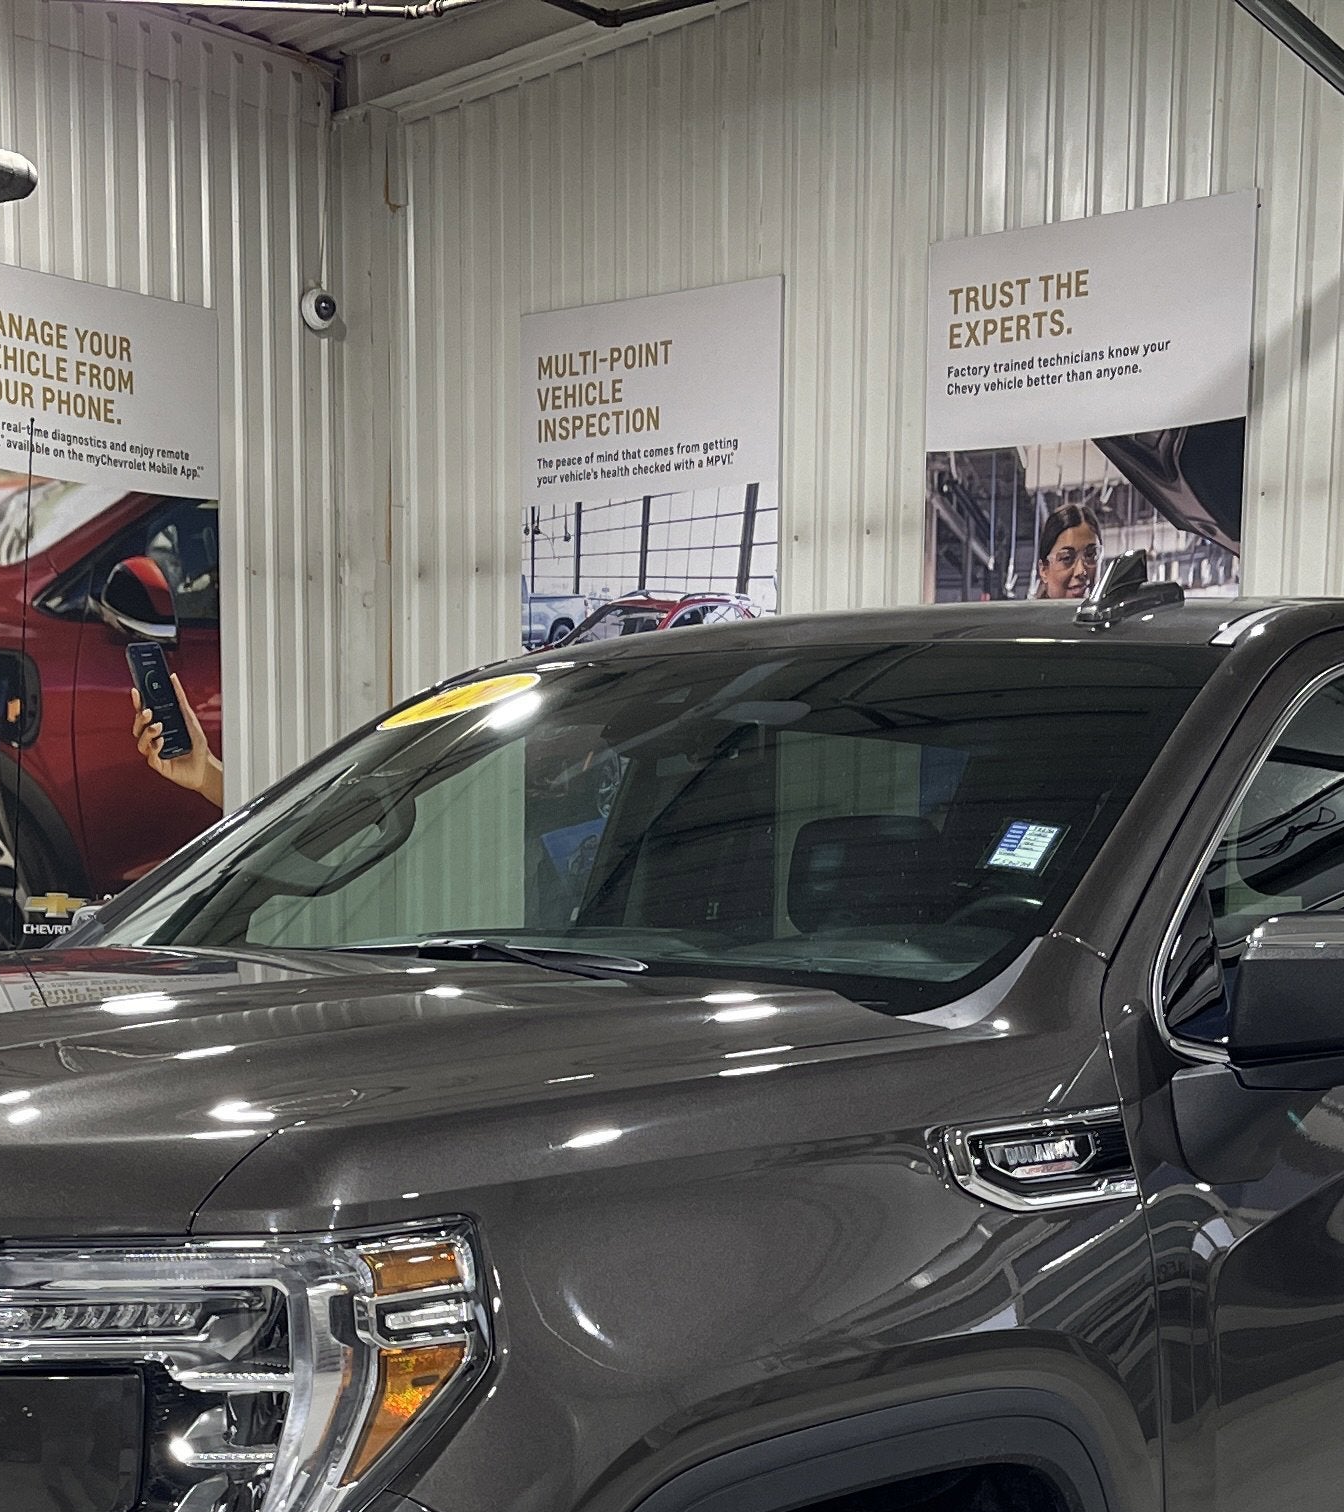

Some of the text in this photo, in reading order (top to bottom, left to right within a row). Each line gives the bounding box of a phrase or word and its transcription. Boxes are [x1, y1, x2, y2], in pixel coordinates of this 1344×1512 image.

[949, 268, 1089, 315] TRUST THE
[75, 327, 131, 362] YOUR
[949, 308, 1073, 349] EXPERTS.
[537, 340, 673, 380] MULTI-POINT
[947, 339, 1171, 379] Factory trained technicians know your
[75, 360, 134, 394] FROM
[947, 363, 1142, 397] Chevy vehicle better than anyone.
[42, 386, 122, 425] PHONE.
[537, 378, 623, 412] VEHICLE
[1, 420, 49, 439] real-tme
[51, 428, 107, 450] diagnostics
[109, 440, 127, 453] and
[129, 443, 155, 460] enjoy
[156, 447, 190, 461] remote
[538, 405, 660, 443] INSPECTION
[53, 447, 65, 459] on
[67, 449, 84, 462] the
[86, 452, 146, 472] myChevrolet
[148, 460, 178, 476] Mobile
[537, 437, 739, 470] The peace of mind that comes from getting
[537, 474, 557, 488] your
[559, 467, 598, 483] vehicle's
[600, 464, 630, 479] health
[632, 460, 671, 476] checked
[673, 457, 695, 472] with
[697, 459, 704, 469] a
[22, 923, 72, 935] CHEVRO
